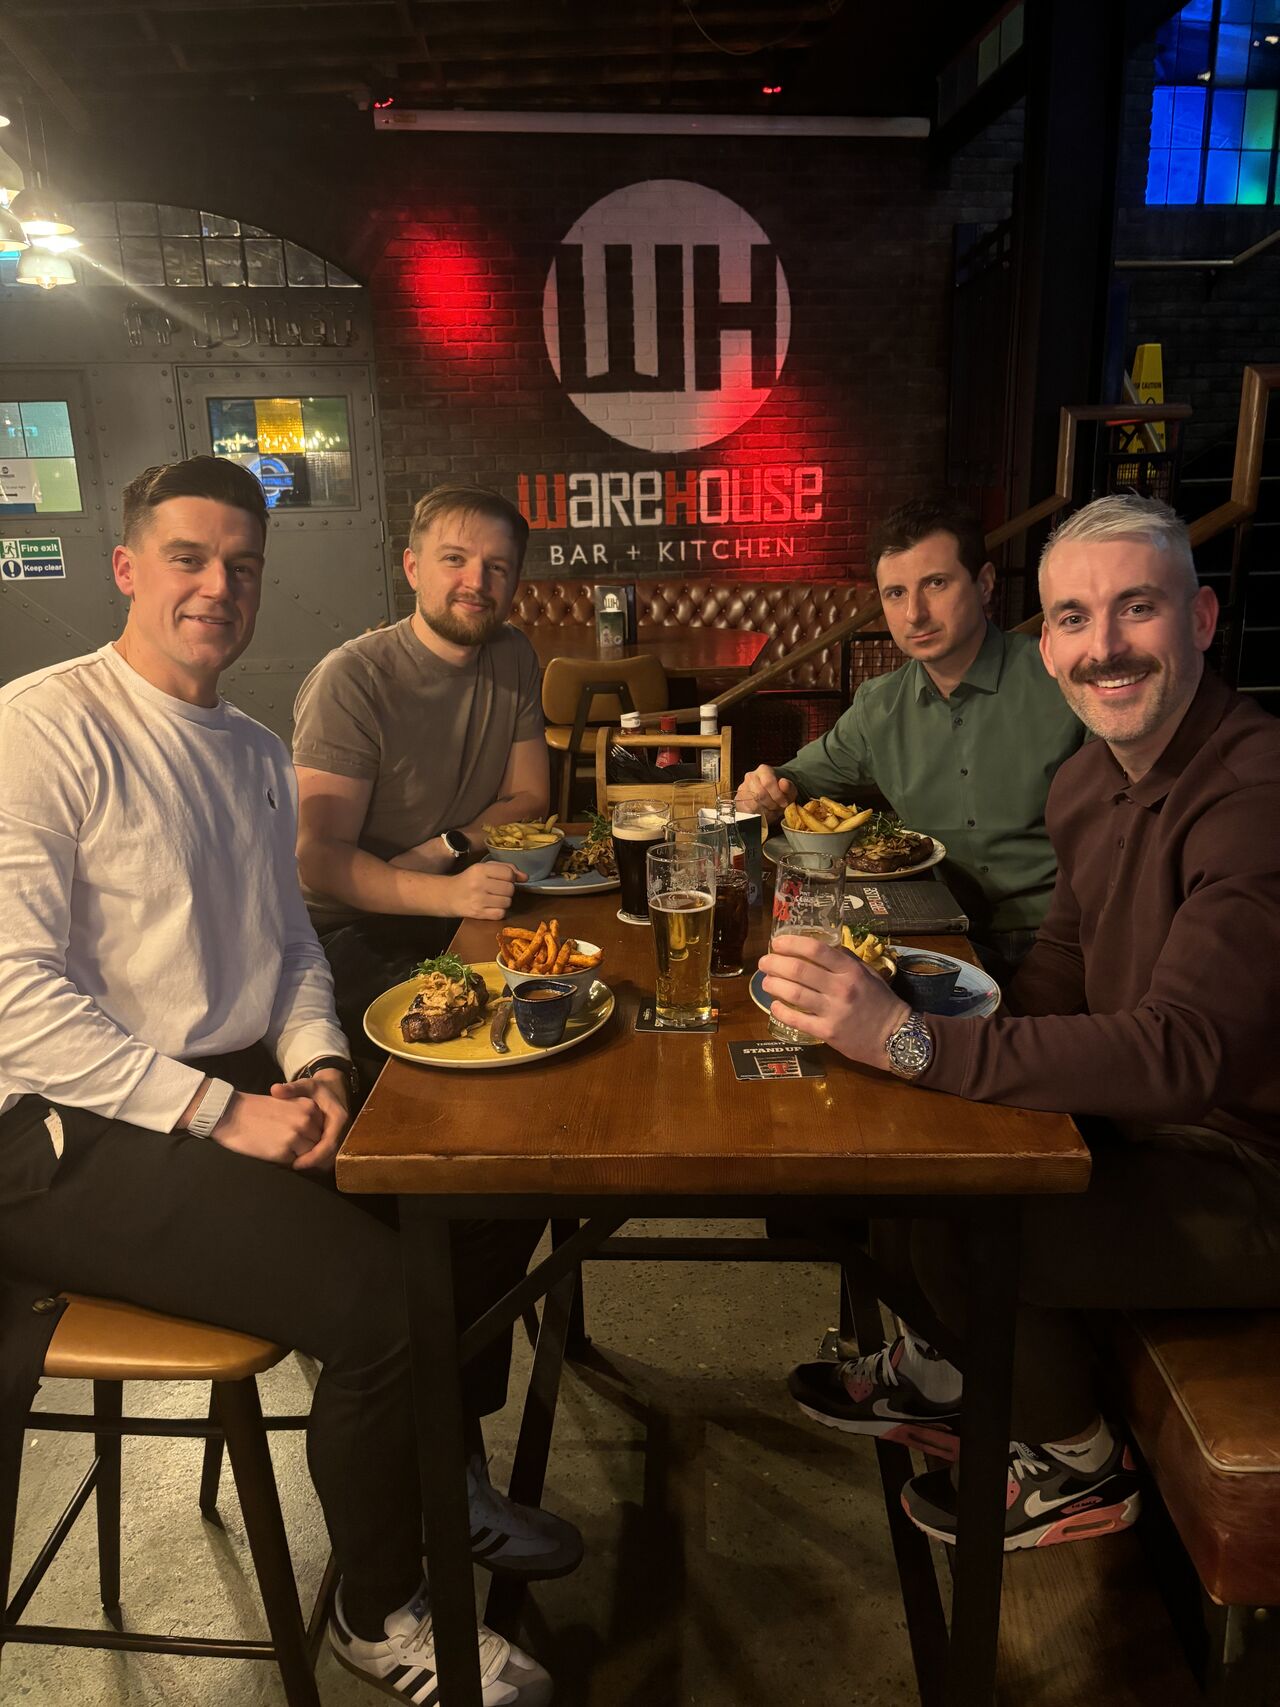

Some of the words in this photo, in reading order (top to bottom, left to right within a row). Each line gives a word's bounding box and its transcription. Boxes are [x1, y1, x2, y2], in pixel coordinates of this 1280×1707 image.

[20, 543, 39, 553] Fire
[40, 543, 58, 552] exit
[550, 544, 608, 566] BAR
[626, 546, 641, 560] +
[658, 537, 795, 562] KITCHEN
[24, 564, 43, 573] Keep
[44, 563, 62, 571] clear
[742, 1047, 784, 1055] STAND
